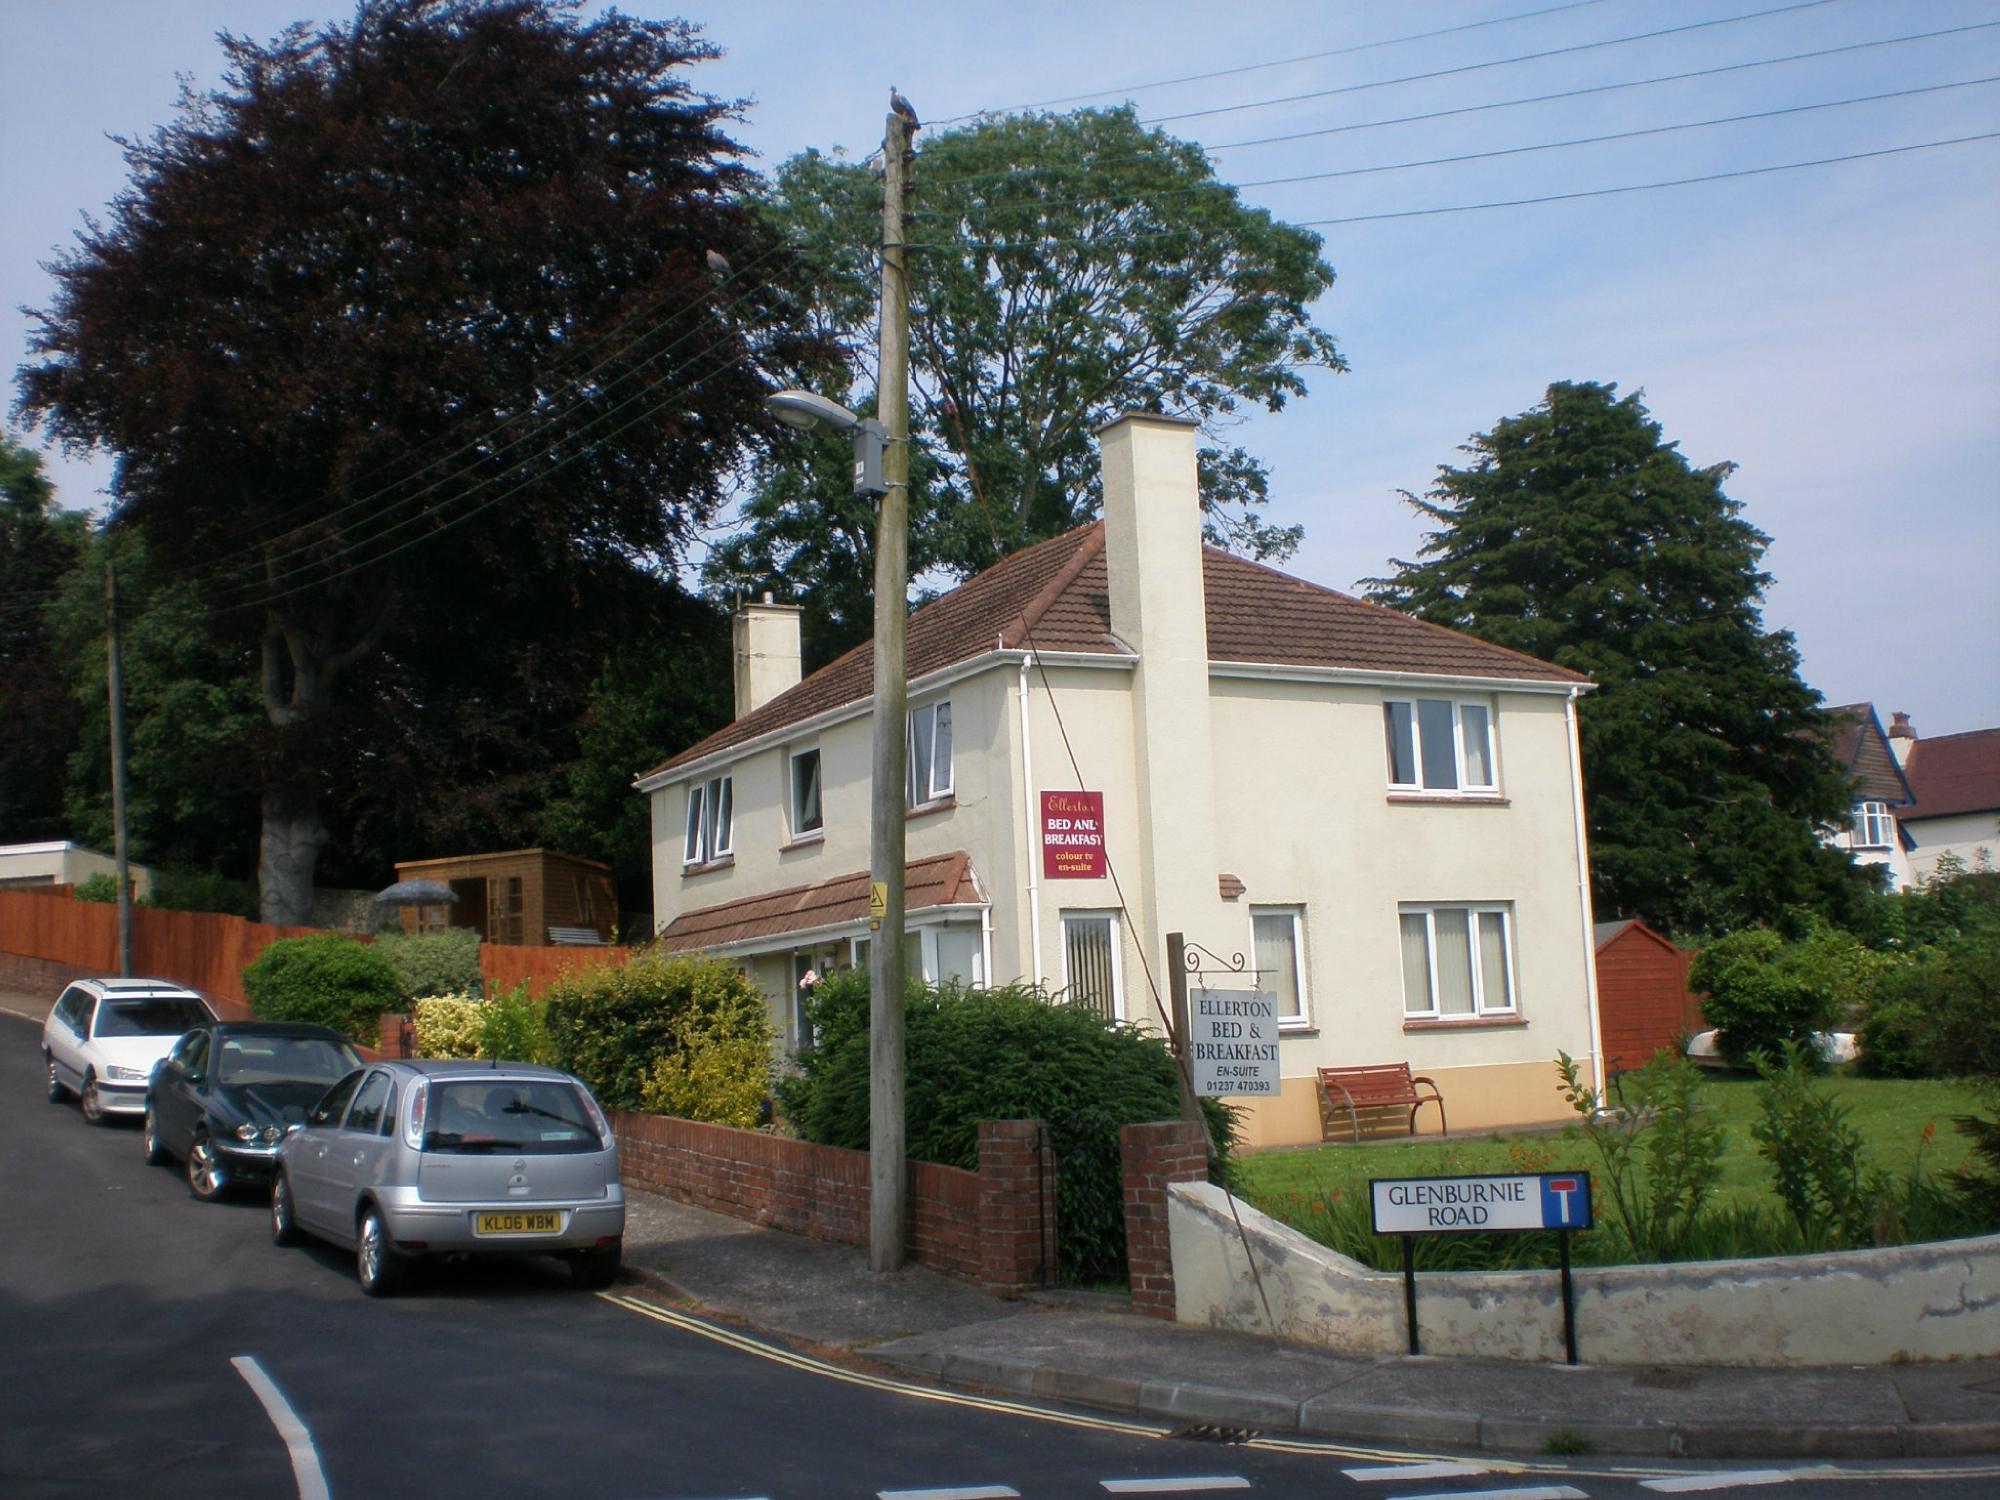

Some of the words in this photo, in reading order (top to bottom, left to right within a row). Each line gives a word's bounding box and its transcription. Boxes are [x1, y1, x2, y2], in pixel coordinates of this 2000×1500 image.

[1047, 818, 1071, 830] BED
[1044, 833, 1103, 846] BREAKFAST
[1055, 851, 1083, 860] colour
[1058, 862, 1093, 871] en-suite
[1199, 1000, 1272, 1017] ELLERTON
[1211, 1021, 1243, 1038] BED
[1249, 1022, 1262, 1039] &
[1195, 1043, 1277, 1061] BREAKFAST
[1216, 1066, 1260, 1077] EN-SUITE
[1206, 1081, 1235, 1092] 01237
[1388, 1182, 1526, 1206] GLENBURNIE
[484, 1216, 523, 1231] KL06
[525, 1215, 554, 1230] WBM
[1428, 1206, 1488, 1226] ROAD
